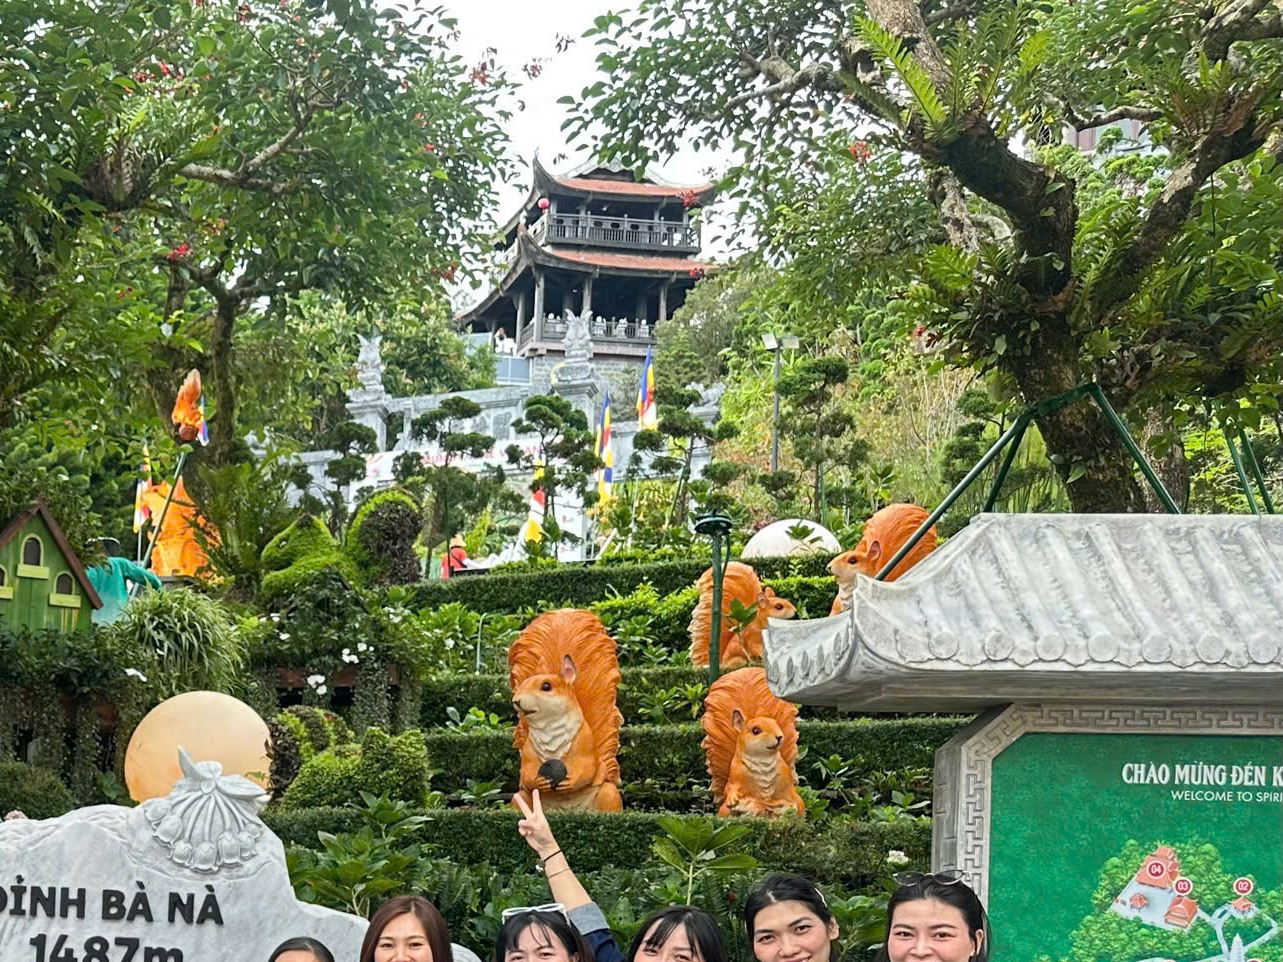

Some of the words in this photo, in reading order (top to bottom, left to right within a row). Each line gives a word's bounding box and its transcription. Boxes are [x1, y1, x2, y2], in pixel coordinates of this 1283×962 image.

[1121, 762, 1170, 784] CHÀO
[1174, 760, 1227, 786] MỪNG
[1171, 790, 1233, 802] WELCOME
[1236, 792, 1253, 802] TO
[1151, 864, 1163, 875] 04
[1177, 881, 1189, 892] 03
[1237, 881, 1249, 891] 02
[101, 880, 153, 923] BÀ
[168, 884, 224, 926] NÀ
